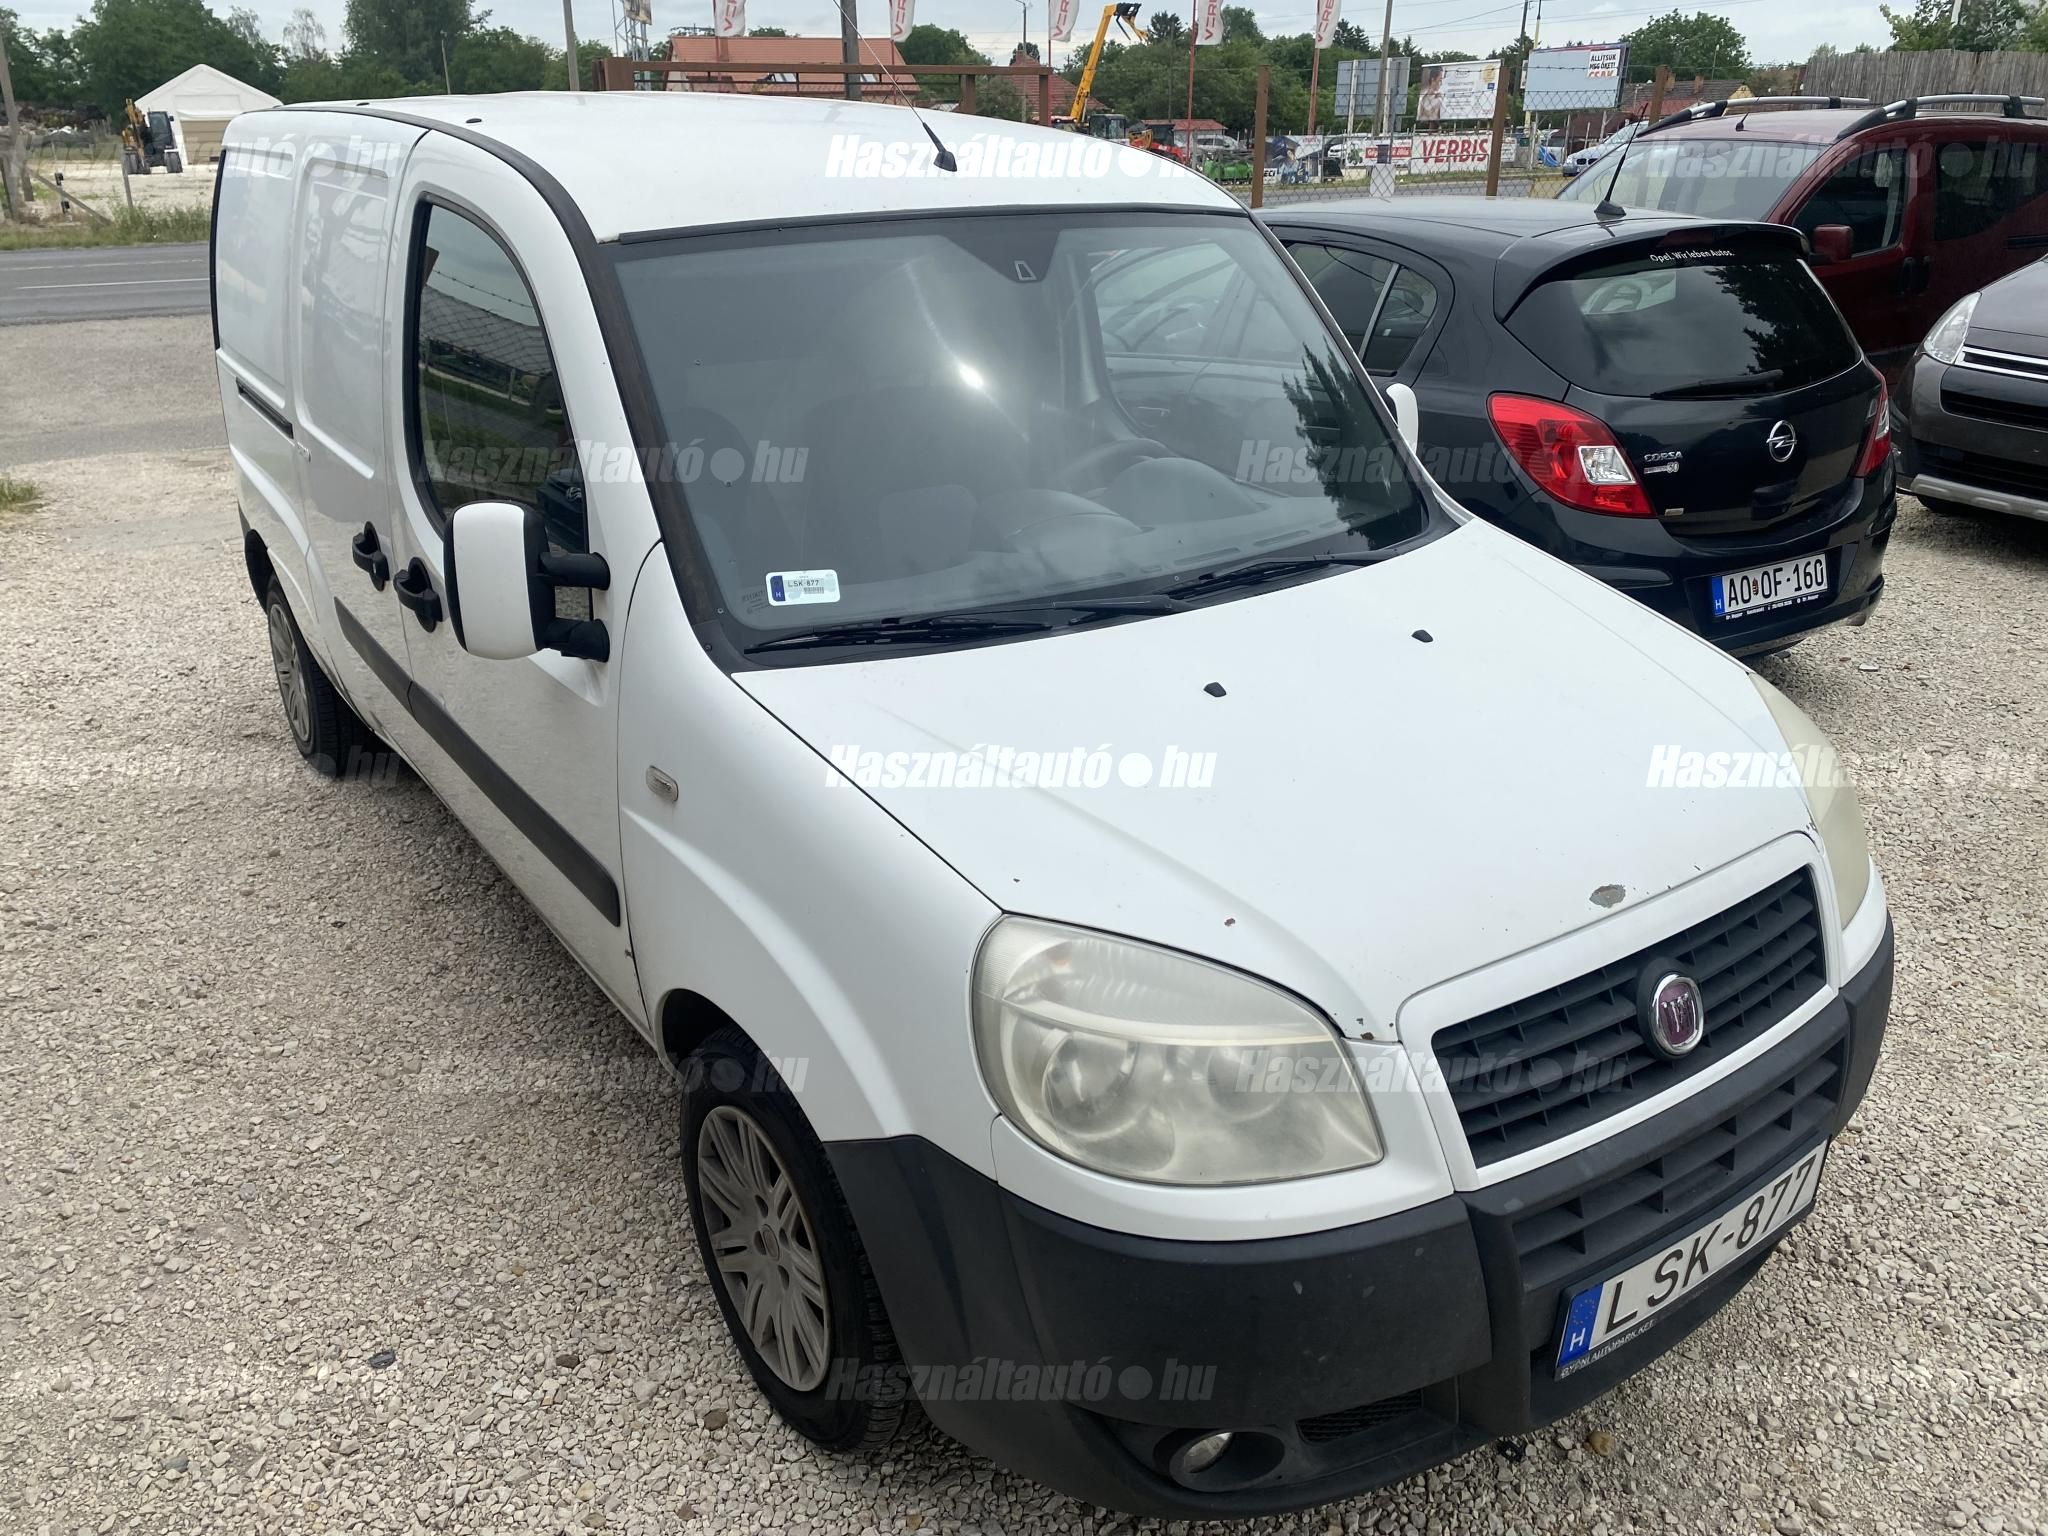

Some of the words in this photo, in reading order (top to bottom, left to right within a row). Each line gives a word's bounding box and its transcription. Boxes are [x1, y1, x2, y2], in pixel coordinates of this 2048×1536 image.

[723, 0, 737, 31] VE
[1204, 0, 1217, 40] VER
[1422, 138, 1489, 163] VERBIS
[1644, 451, 1683, 462] CORSA
[1728, 575, 1752, 608] AO
[1761, 558, 1824, 599] OF-160
[1715, 599, 1722, 609] H
[1605, 1153, 1817, 1336] LSK-877
[1569, 1327, 1586, 1352] H
